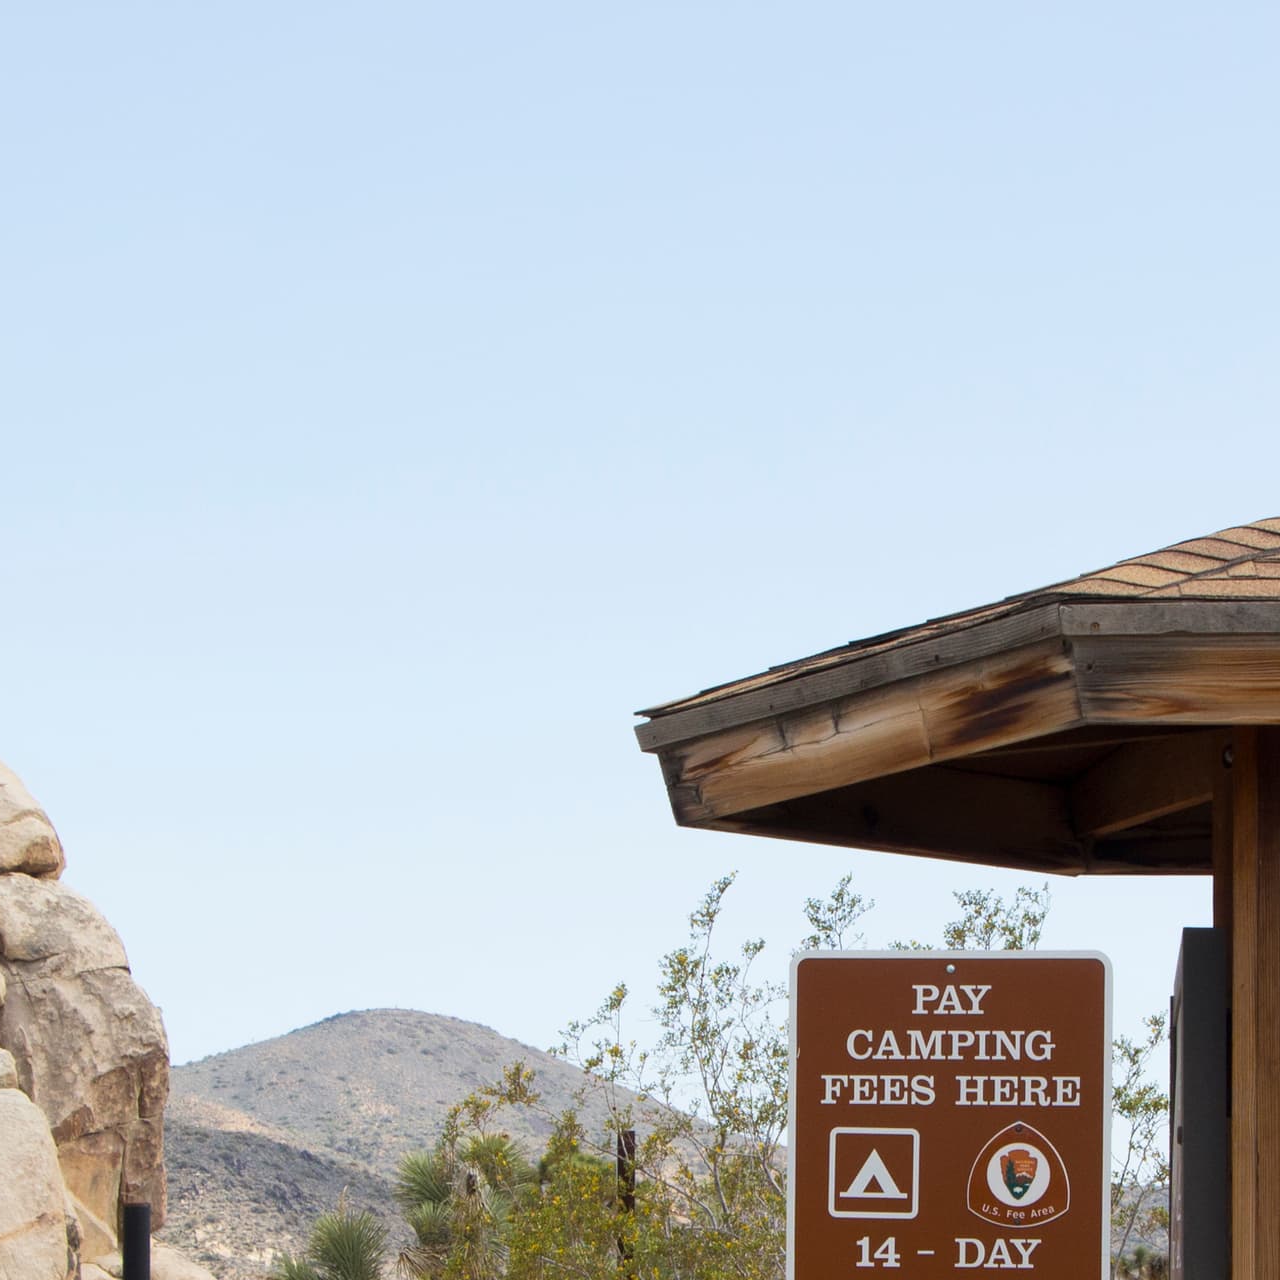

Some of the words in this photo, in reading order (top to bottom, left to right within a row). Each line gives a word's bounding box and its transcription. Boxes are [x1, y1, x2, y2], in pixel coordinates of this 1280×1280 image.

[911, 984, 991, 1014] PAY
[846, 1029, 1056, 1060] CAMPING
[820, 1074, 935, 1105] FEES
[954, 1075, 1080, 1106] HERE
[981, 1203, 1001, 1217] U.S.
[1006, 1209, 1026, 1220] Fee
[1030, 1205, 1055, 1219] Area
[855, 1236, 900, 1267] 14
[954, 1237, 1041, 1268] DAY
